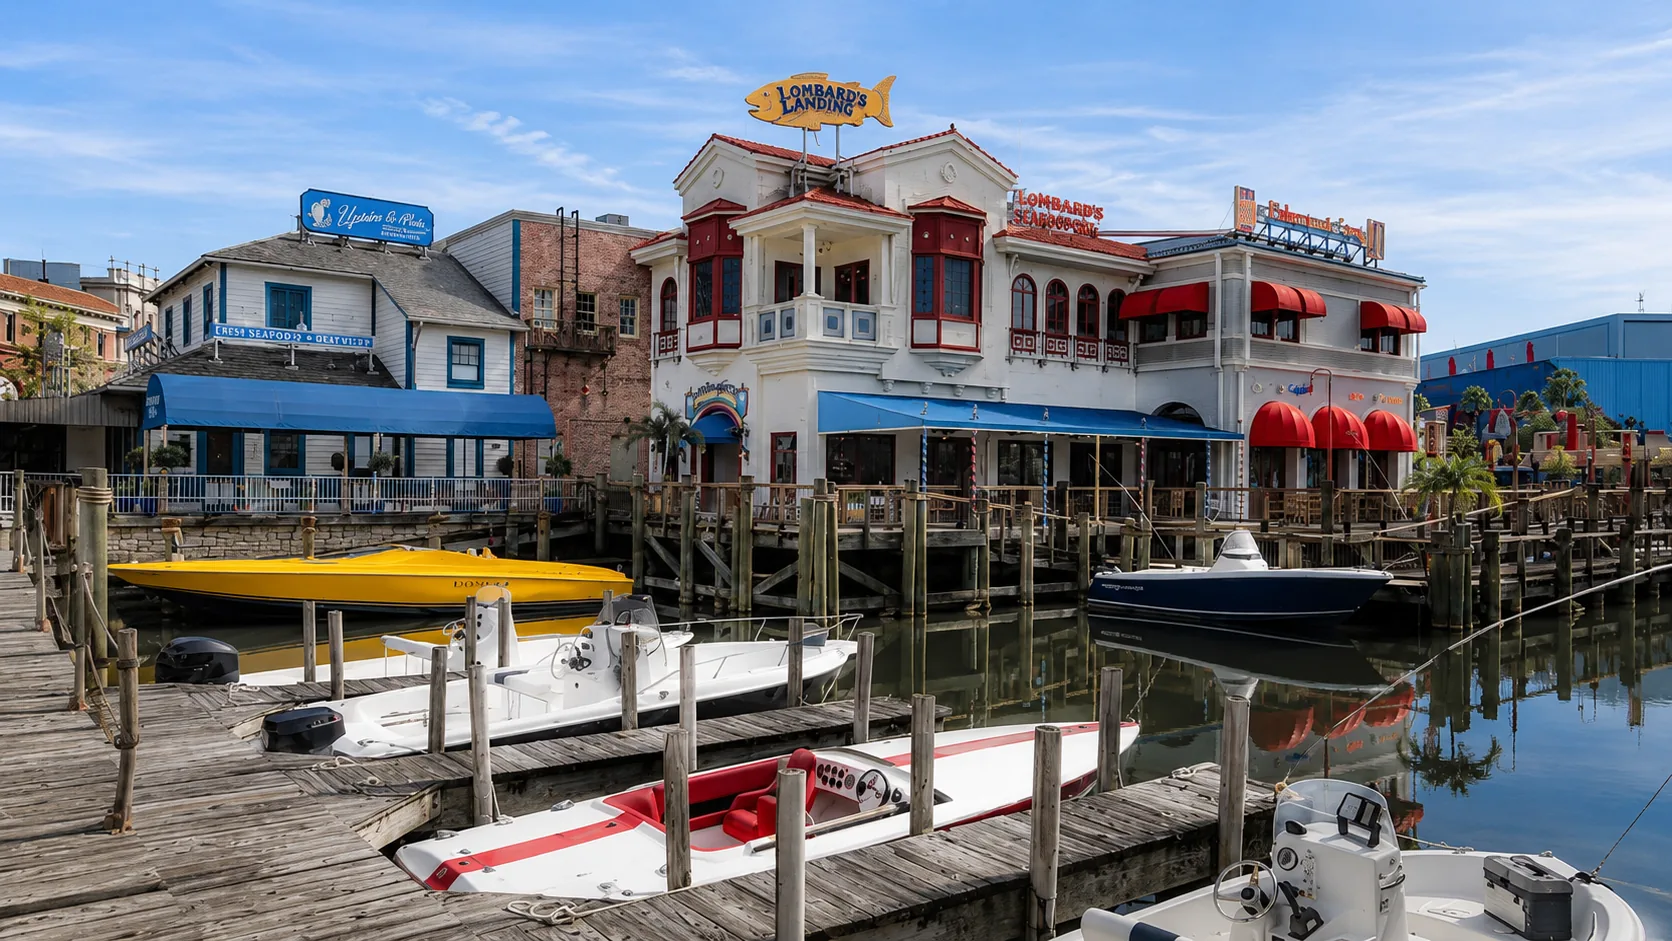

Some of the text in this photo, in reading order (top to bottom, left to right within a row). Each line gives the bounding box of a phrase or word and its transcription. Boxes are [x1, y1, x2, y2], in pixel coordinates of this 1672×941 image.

[776, 84, 868, 107] LOMBARD'S
[780, 96, 856, 117] LANDING
[1018, 189, 1104, 221] LOMBARD'S
